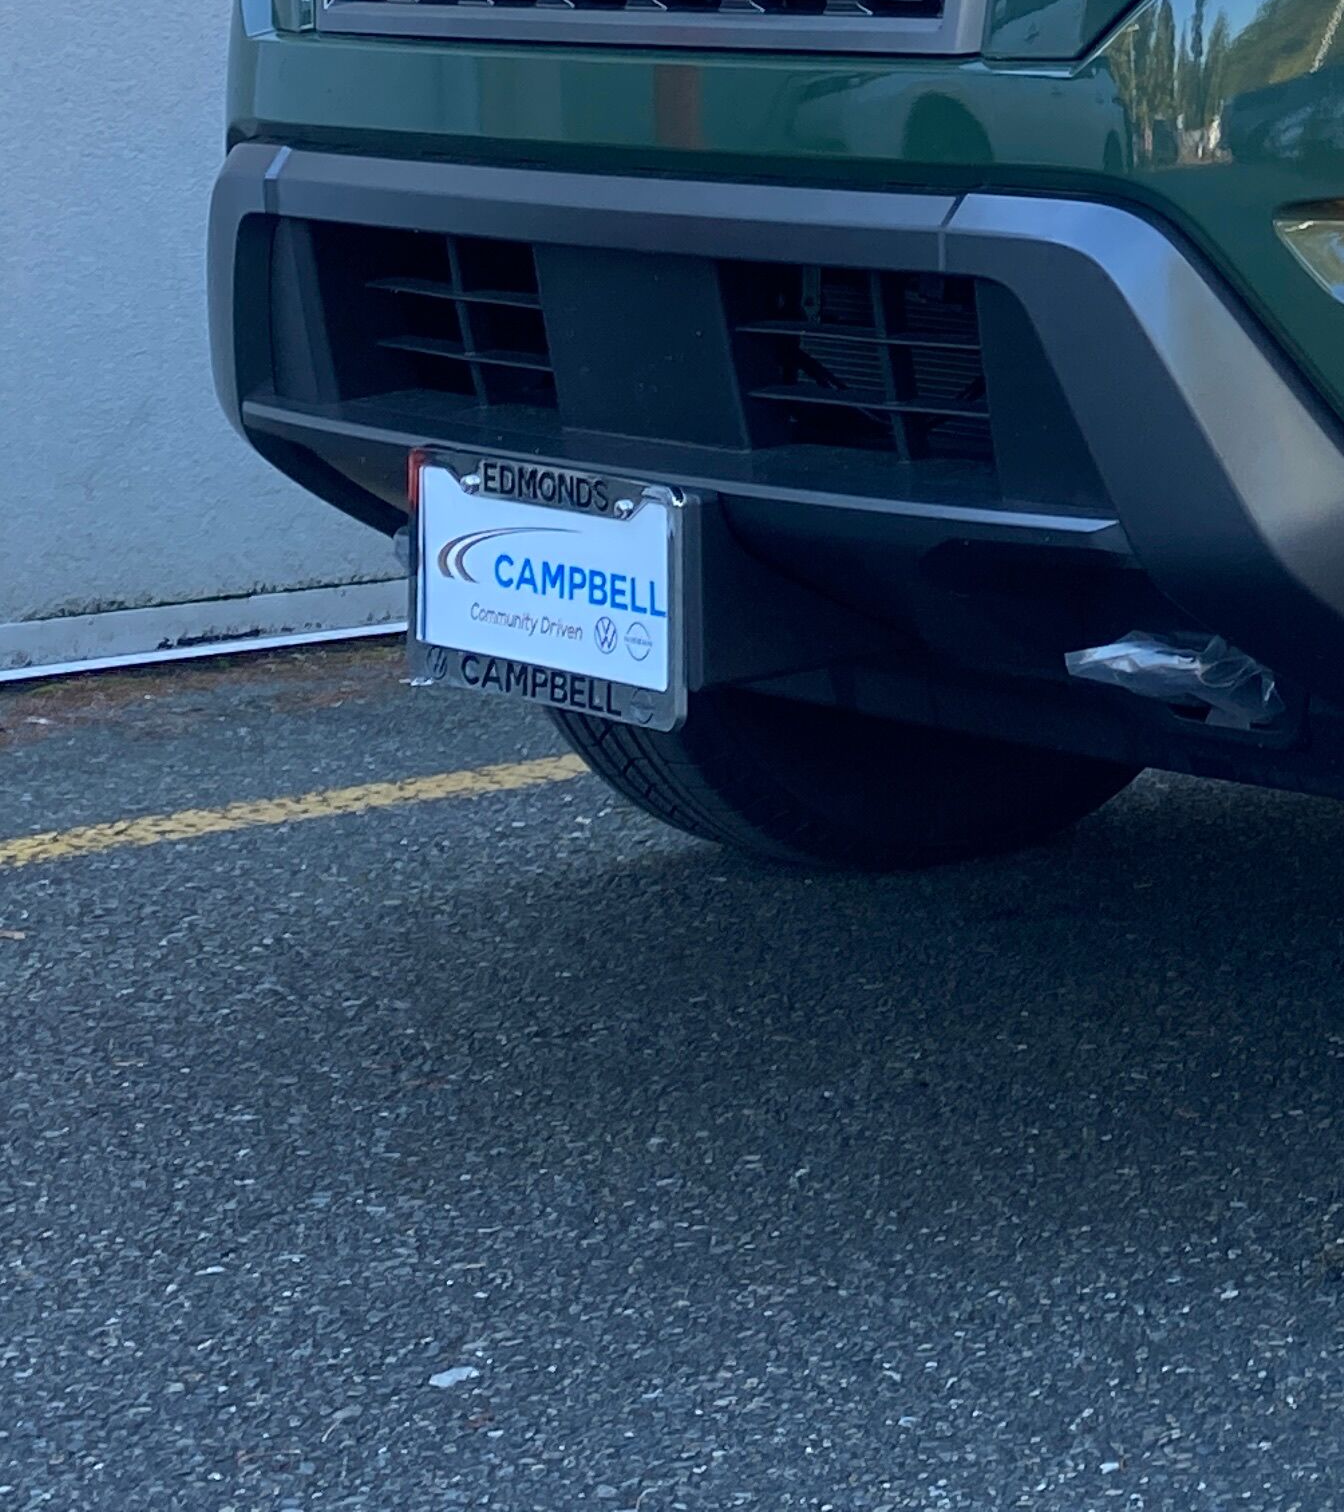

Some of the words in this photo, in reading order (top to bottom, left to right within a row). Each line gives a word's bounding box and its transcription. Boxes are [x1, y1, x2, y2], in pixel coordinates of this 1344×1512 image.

[482, 462, 610, 513] EDMONDS
[494, 553, 667, 618] CAMPBELL
[470, 601, 539, 638] Community
[540, 615, 584, 642] Driven
[461, 654, 622, 717] CAMPBELL
